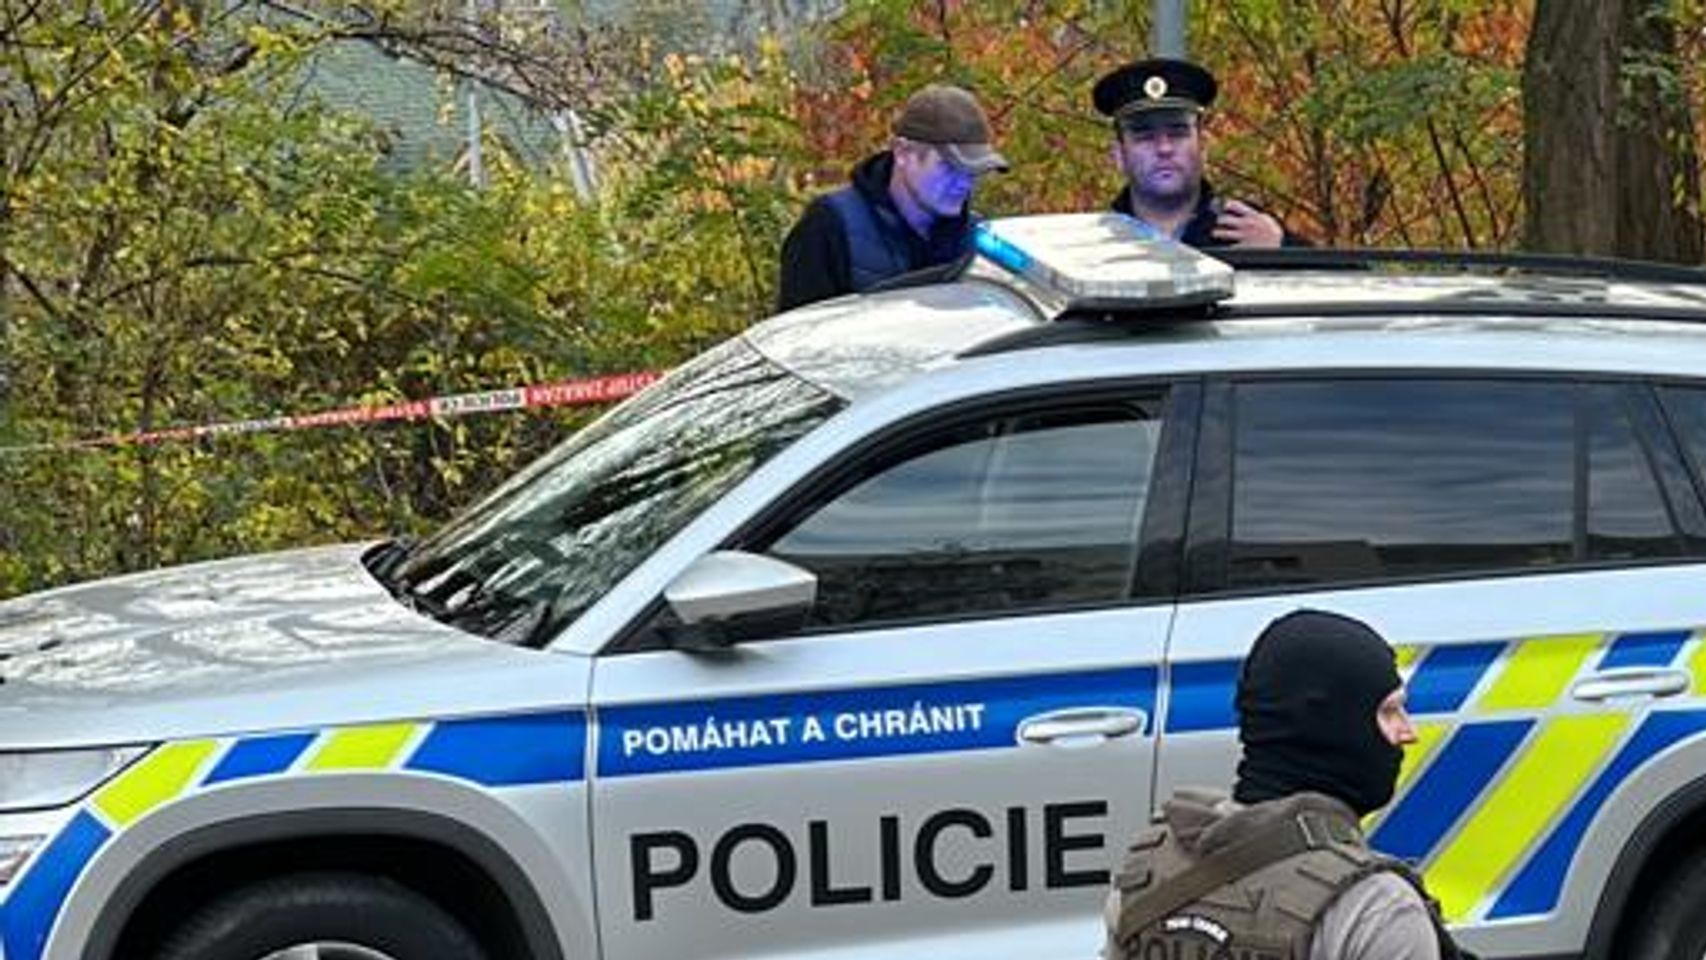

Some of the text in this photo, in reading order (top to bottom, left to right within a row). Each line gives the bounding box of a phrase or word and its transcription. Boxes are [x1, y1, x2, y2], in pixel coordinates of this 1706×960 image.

[623, 703, 985, 757] POMÁHAT A CHRÁNIT
[630, 800, 1111, 921] POLICIE
